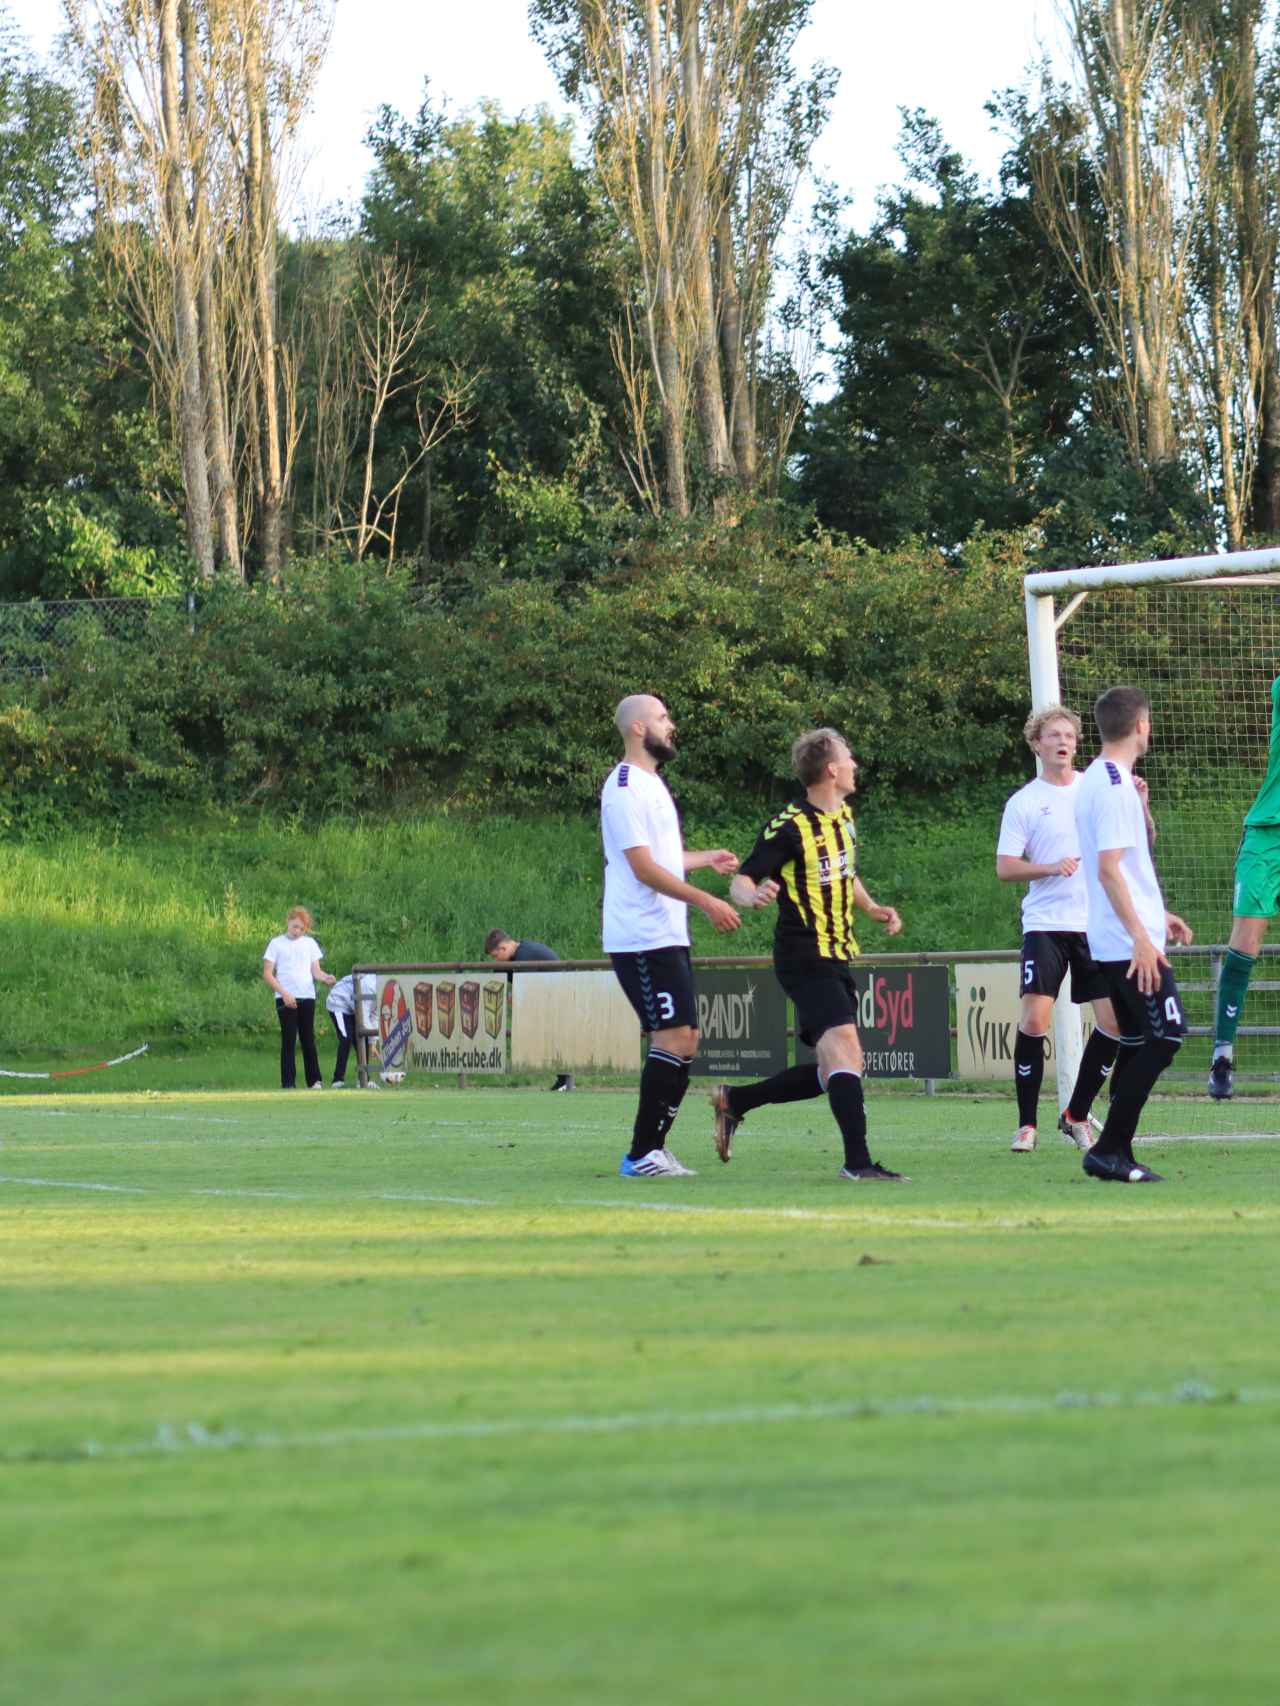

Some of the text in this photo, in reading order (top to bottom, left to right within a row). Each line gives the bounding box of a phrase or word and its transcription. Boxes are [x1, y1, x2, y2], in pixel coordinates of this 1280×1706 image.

[1023, 960, 1034, 985] 5
[655, 992, 675, 1020] 3
[694, 992, 753, 1040] RANDT
[1164, 996, 1182, 1025] 4
[413, 1047, 502, 1071] www.thai-cube.dk
